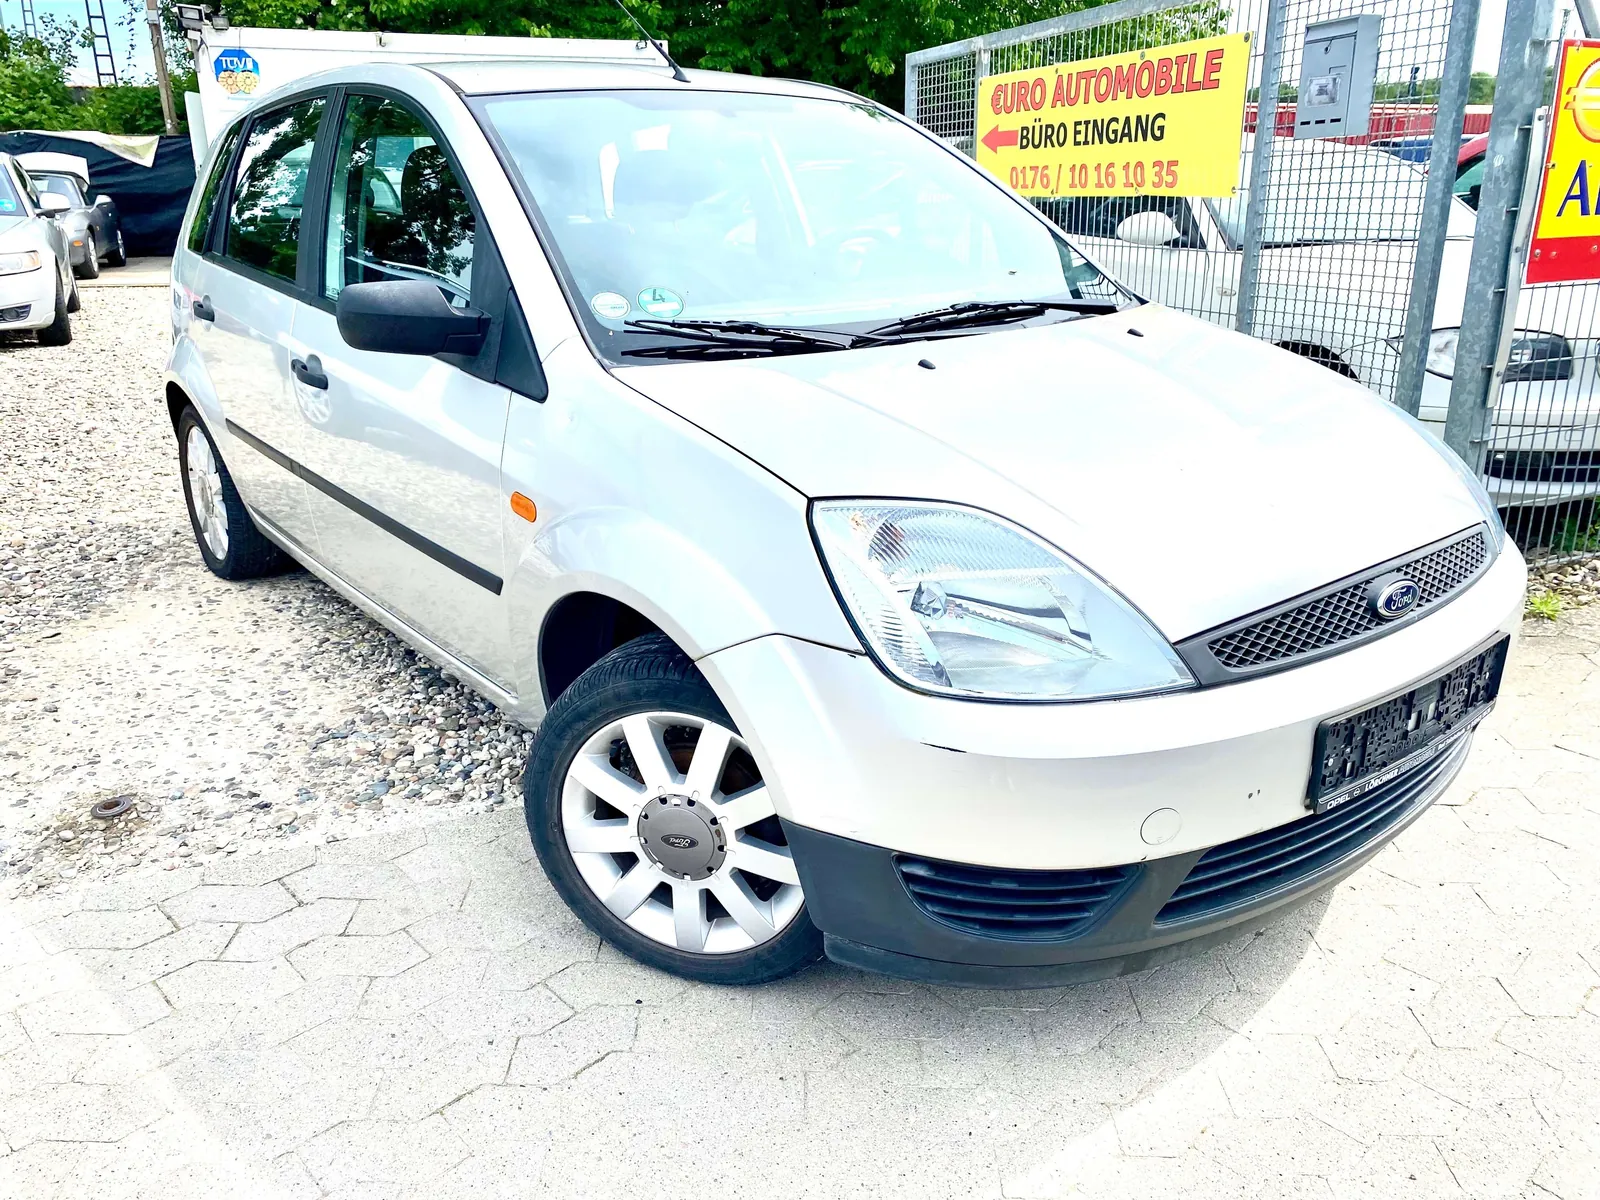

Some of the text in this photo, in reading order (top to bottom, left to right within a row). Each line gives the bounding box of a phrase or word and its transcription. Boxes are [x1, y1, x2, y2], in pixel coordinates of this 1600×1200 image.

[991, 48, 1225, 115] €URO AUTOMOBILE
[1019, 112, 1166, 150] BÜRO EINGANG
[1010, 165, 1051, 190] 0176
[1068, 164, 1089, 189] 10
[1094, 162, 1116, 188] 16
[1122, 160, 1146, 188] 10
[1152, 160, 1179, 188] 35
[1556, 159, 1600, 217] A
[1390, 587, 1413, 610] Ford
[1326, 793, 1351, 810] OPEL
[669, 837, 691, 847] Ford
